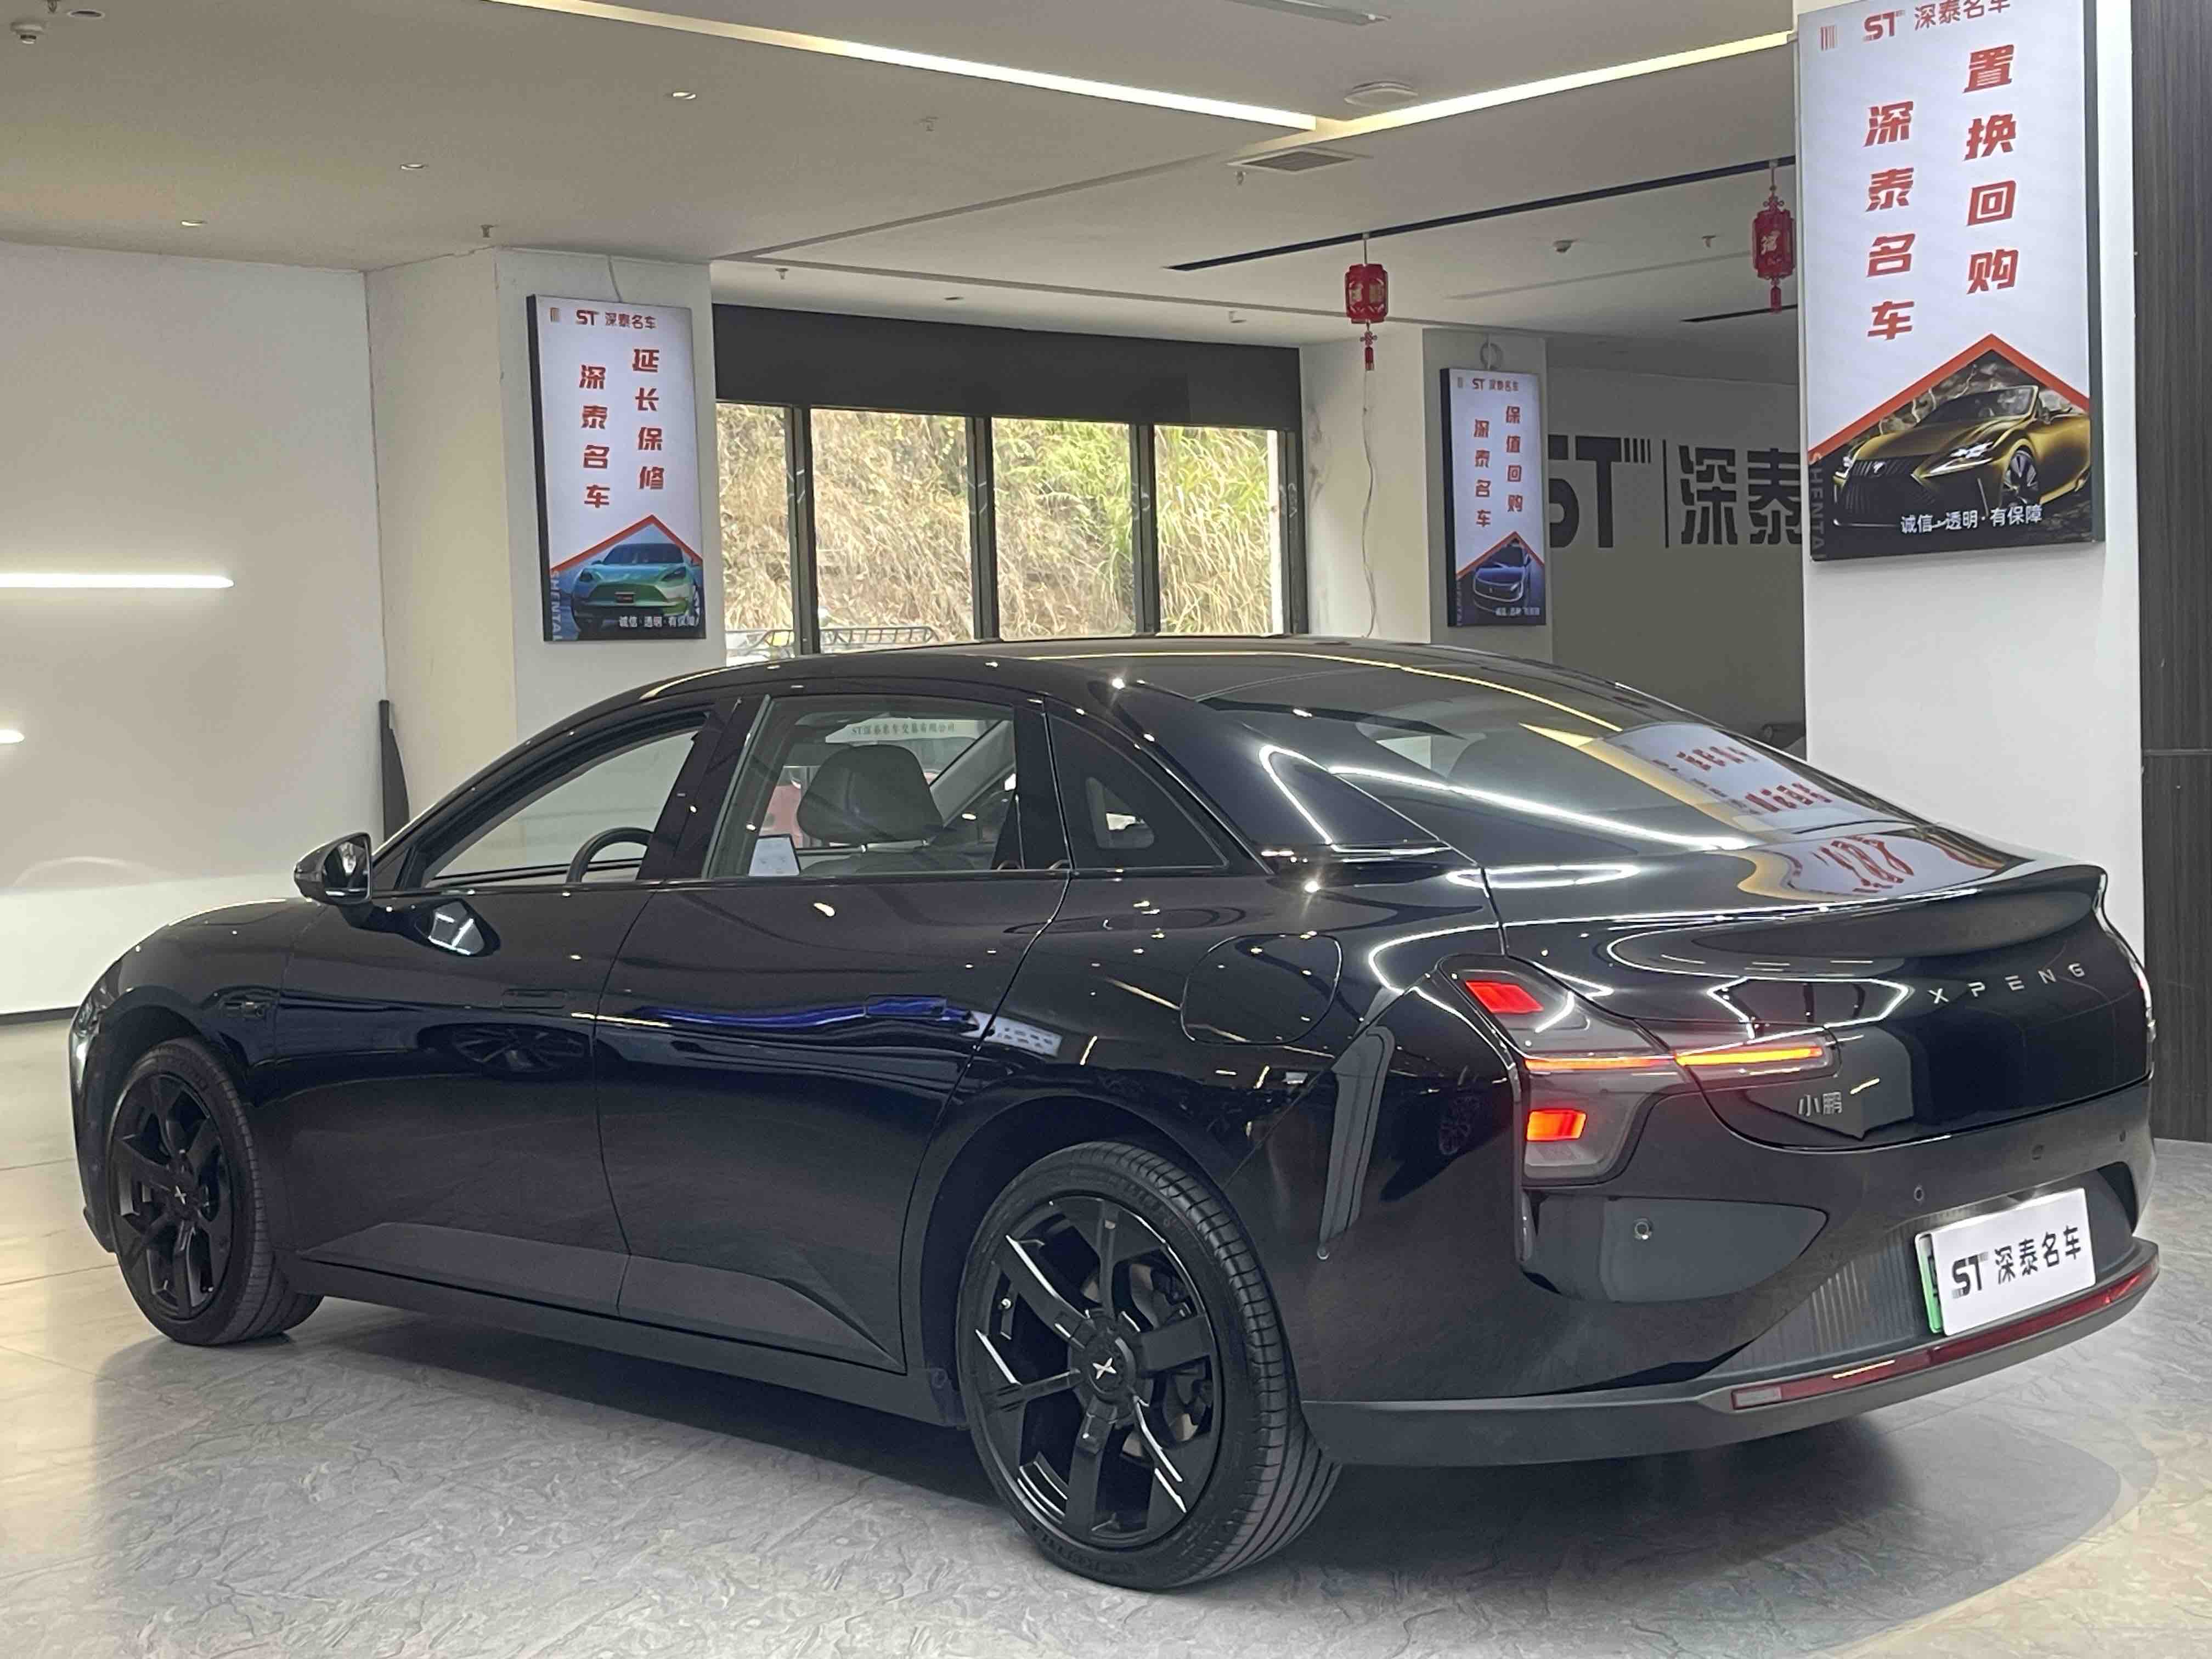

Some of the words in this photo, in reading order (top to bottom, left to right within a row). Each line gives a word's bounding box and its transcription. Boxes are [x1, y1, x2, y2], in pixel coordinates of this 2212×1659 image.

[1864, 11, 1904, 42] ST
[1962, 44, 2018, 294] 置换回购
[1863, 101, 1915, 340] 深泰名车
[576, 309, 599, 325] ST
[579, 364, 610, 509] 深泰名车
[632, 348, 664, 490] 延长保修
[1505, 405, 1522, 512] 保值回购
[1679, 445, 1803, 545] 深泰
[1928, 963, 2085, 1004] XPENG
[1798, 1092, 1842, 1116] 小鹏
[1951, 1251, 1988, 1298] ST
[1994, 1226, 2081, 1284] 深泰名车
